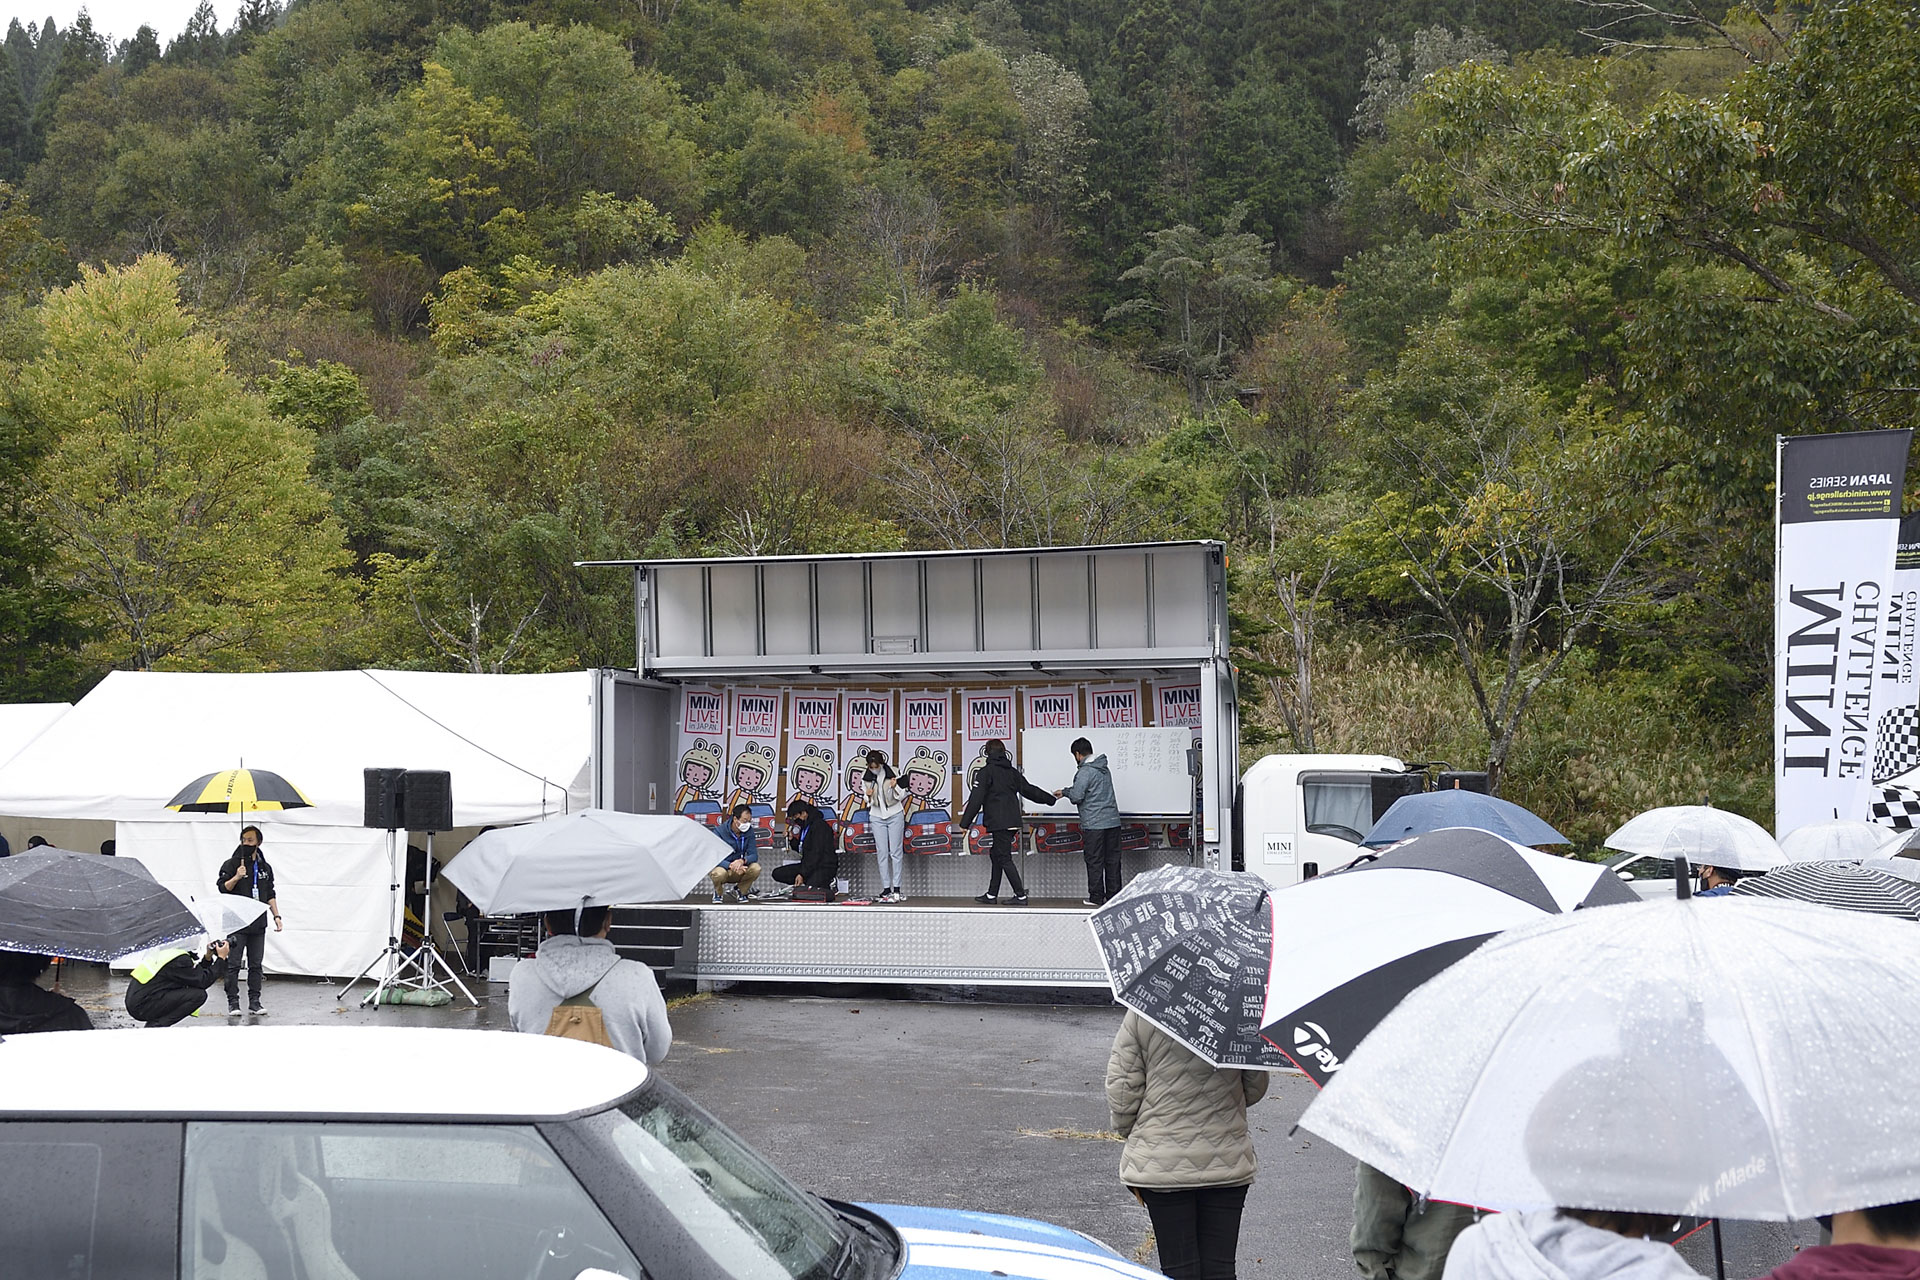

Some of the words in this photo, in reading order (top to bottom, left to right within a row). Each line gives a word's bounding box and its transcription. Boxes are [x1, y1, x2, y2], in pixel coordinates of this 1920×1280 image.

[690, 696, 720, 710] MINI
[1097, 695, 1132, 709] MINI
[1164, 689, 1200, 704] MINI
[742, 699, 774, 712] MINI
[799, 702, 832, 715] MINI
[852, 702, 884, 716] MINI
[909, 703, 943, 716] MINI
[972, 701, 1007, 715] MINI
[1035, 699, 1069, 713] MINI
[1165, 703, 1200, 718] LIVE!
[690, 710, 719, 724] LIVE!
[740, 712, 773, 726] LIVE!
[799, 715, 831, 728] LIVE!
[852, 716, 884, 730] LIVE!
[909, 717, 943, 730] LIVE!
[973, 715, 1007, 728] LIVE!
[1035, 713, 1070, 727] LIVE!
[1098, 709, 1133, 724] LIVE!
[1268, 842, 1291, 850] MINI
[1172, 954, 1192, 969] EARLY
[1164, 966, 1185, 982] RAIN
[1134, 984, 1158, 1005] fine
[1124, 992, 1147, 1012] rain
[1182, 992, 1215, 1016] ANYTIME
[1211, 997, 1230, 1013] RAIN
[1164, 1006, 1189, 1026] shower
[1184, 1004, 1226, 1034] ANYWHERE
[1243, 1009, 1263, 1018] RAIN
[1188, 1037, 1218, 1060] SEASON
[1199, 1035, 1218, 1049] ALL
[1228, 1041, 1252, 1052] fine
[1222, 1052, 1246, 1064] rain
